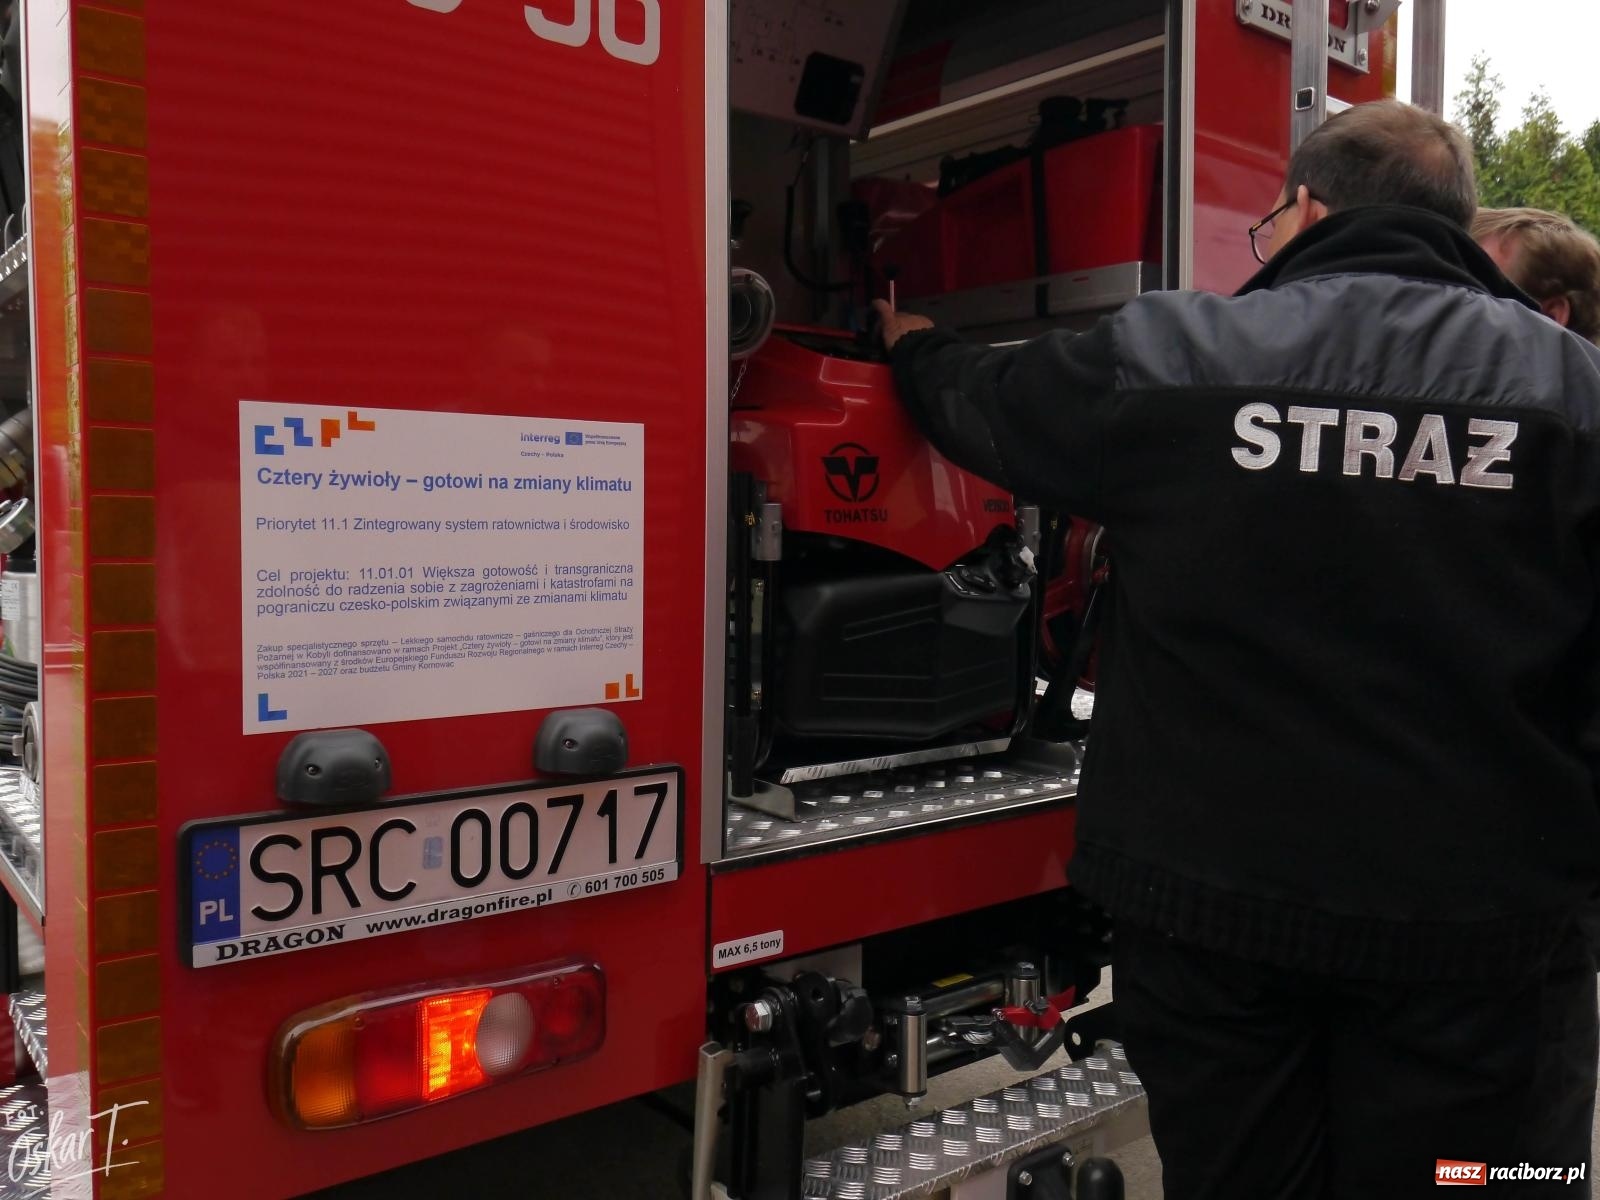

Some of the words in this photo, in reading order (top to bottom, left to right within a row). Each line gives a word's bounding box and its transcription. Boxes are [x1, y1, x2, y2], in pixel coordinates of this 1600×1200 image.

[520, 432, 560, 444] Interreg
[1231, 402, 1519, 489] STRAŻ
[257, 467, 322, 490] Cztery
[329, 469, 401, 491] żywioły
[423, 473, 482, 492] gotowi
[488, 477, 508, 489] na
[514, 475, 571, 494] zmiany
[577, 475, 632, 491] klimatu
[256, 517, 316, 533] Priorytet
[322, 518, 348, 530] 11.1
[353, 518, 442, 533] Zintegrowany
[445, 519, 488, 532] system
[492, 518, 560, 530] ratownictwa
[563, 518, 567, 530] i
[569, 518, 630, 530] środowisko
[824, 508, 888, 523] TOHATSU
[256, 569, 281, 582] Cel
[290, 568, 349, 584] projektu:
[359, 567, 414, 579] 11.01.01
[423, 565, 475, 580] Większa
[482, 564, 538, 579] gotowość
[545, 564, 549, 575] i
[555, 563, 633, 577] transgraniczna
[257, 584, 320, 598] zdolność
[325, 584, 342, 596] do
[348, 582, 405, 595] radzenia
[410, 581, 443, 593] sobie
[449, 583, 456, 592] z
[460, 579, 539, 594] zagrożeniami
[543, 578, 547, 589] i
[550, 577, 616, 589] katastrofami
[620, 577, 633, 587] na
[257, 600, 334, 617] pograniczu
[339, 597, 439, 612] czesko-polskim
[444, 594, 512, 608] związanymi
[517, 596, 530, 605] ze
[533, 592, 587, 604] zmianami
[590, 590, 627, 602] klimatu
[257, 672, 285, 680] Polska
[288, 670, 307, 678] 2021
[318, 668, 337, 676] 2027
[359, 664, 390, 673] budżetu
[249, 816, 417, 922] SRC
[450, 782, 668, 888] 00717
[200, 900, 234, 925] PL
[215, 924, 346, 962] DRAGON
[366, 888, 553, 934] www.dragonfire.pl
[585, 874, 611, 895] 601
[614, 871, 638, 891] 700
[642, 868, 665, 887] 505
[718, 946, 742, 960] MAX
[744, 942, 759, 957] 6,5
[760, 937, 782, 955] tony
